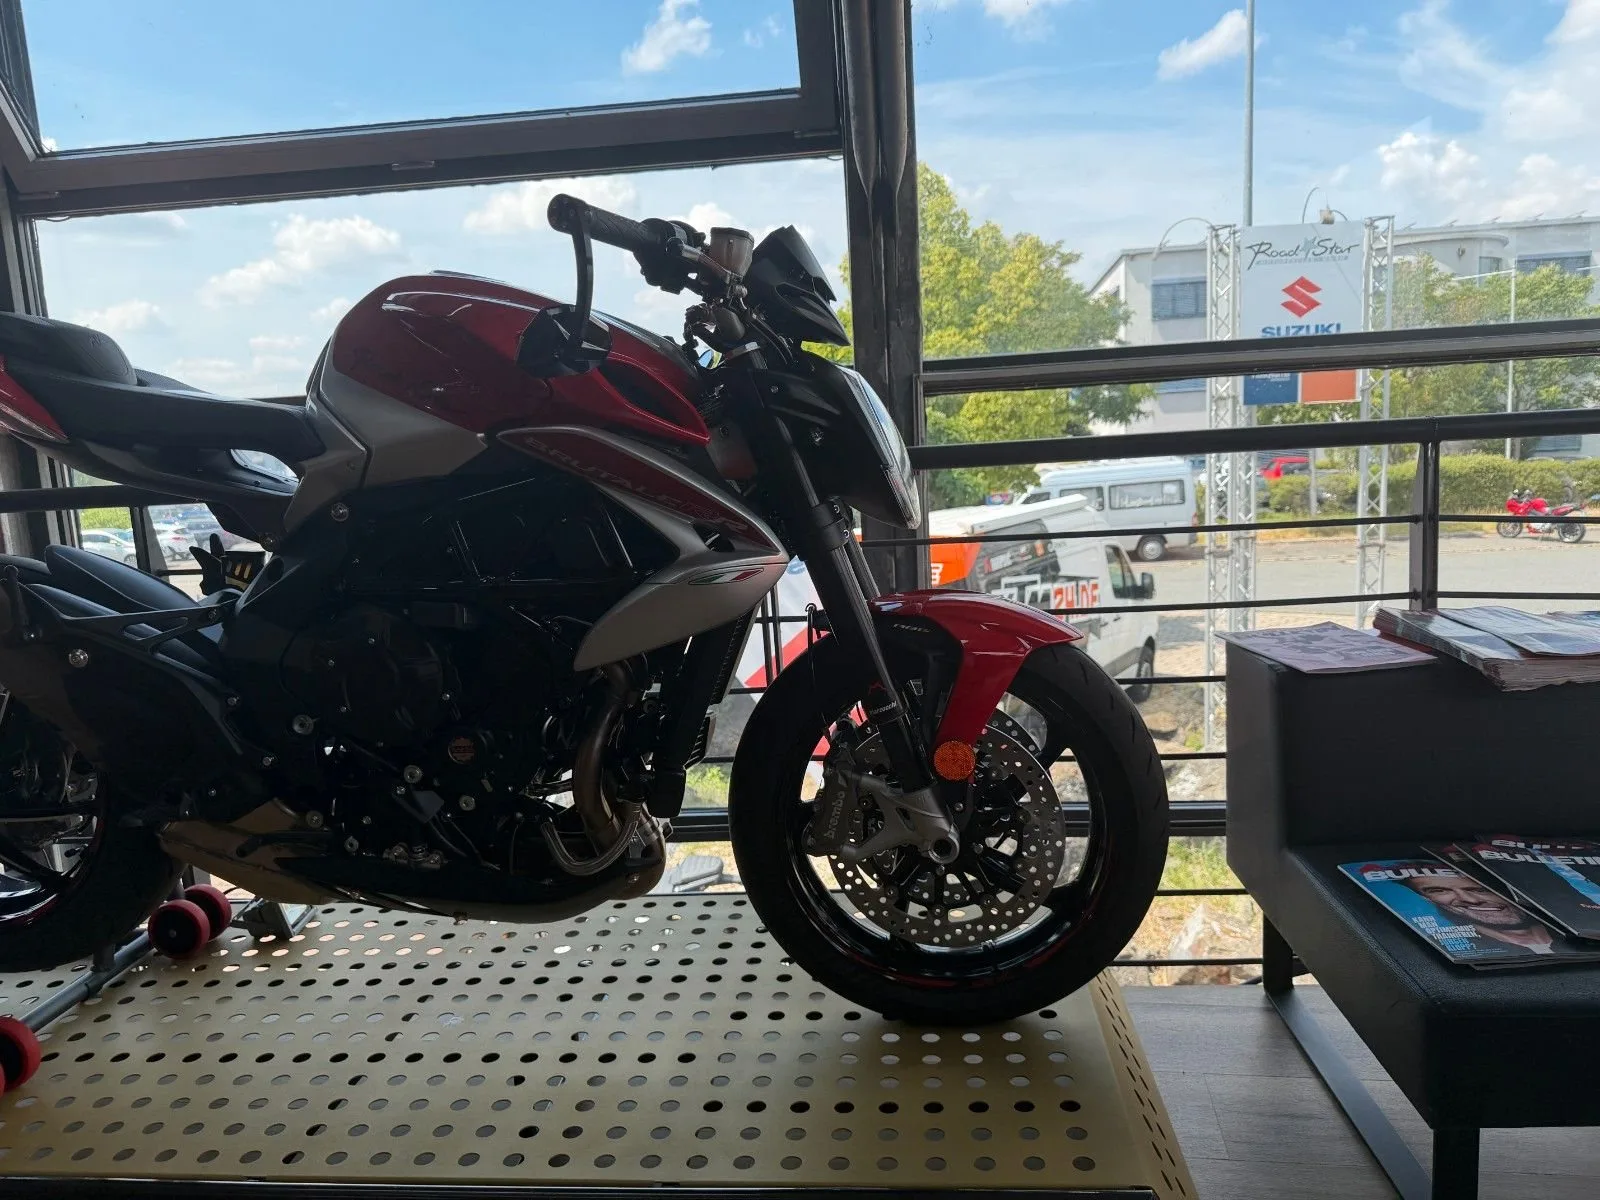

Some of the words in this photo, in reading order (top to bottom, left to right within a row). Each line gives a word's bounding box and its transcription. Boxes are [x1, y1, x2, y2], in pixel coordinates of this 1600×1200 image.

[1245, 241, 1301, 271] Road
[1311, 238, 1360, 257] Star
[1261, 323, 1342, 338] SUZUKI
[823, 790, 846, 840] brembo
